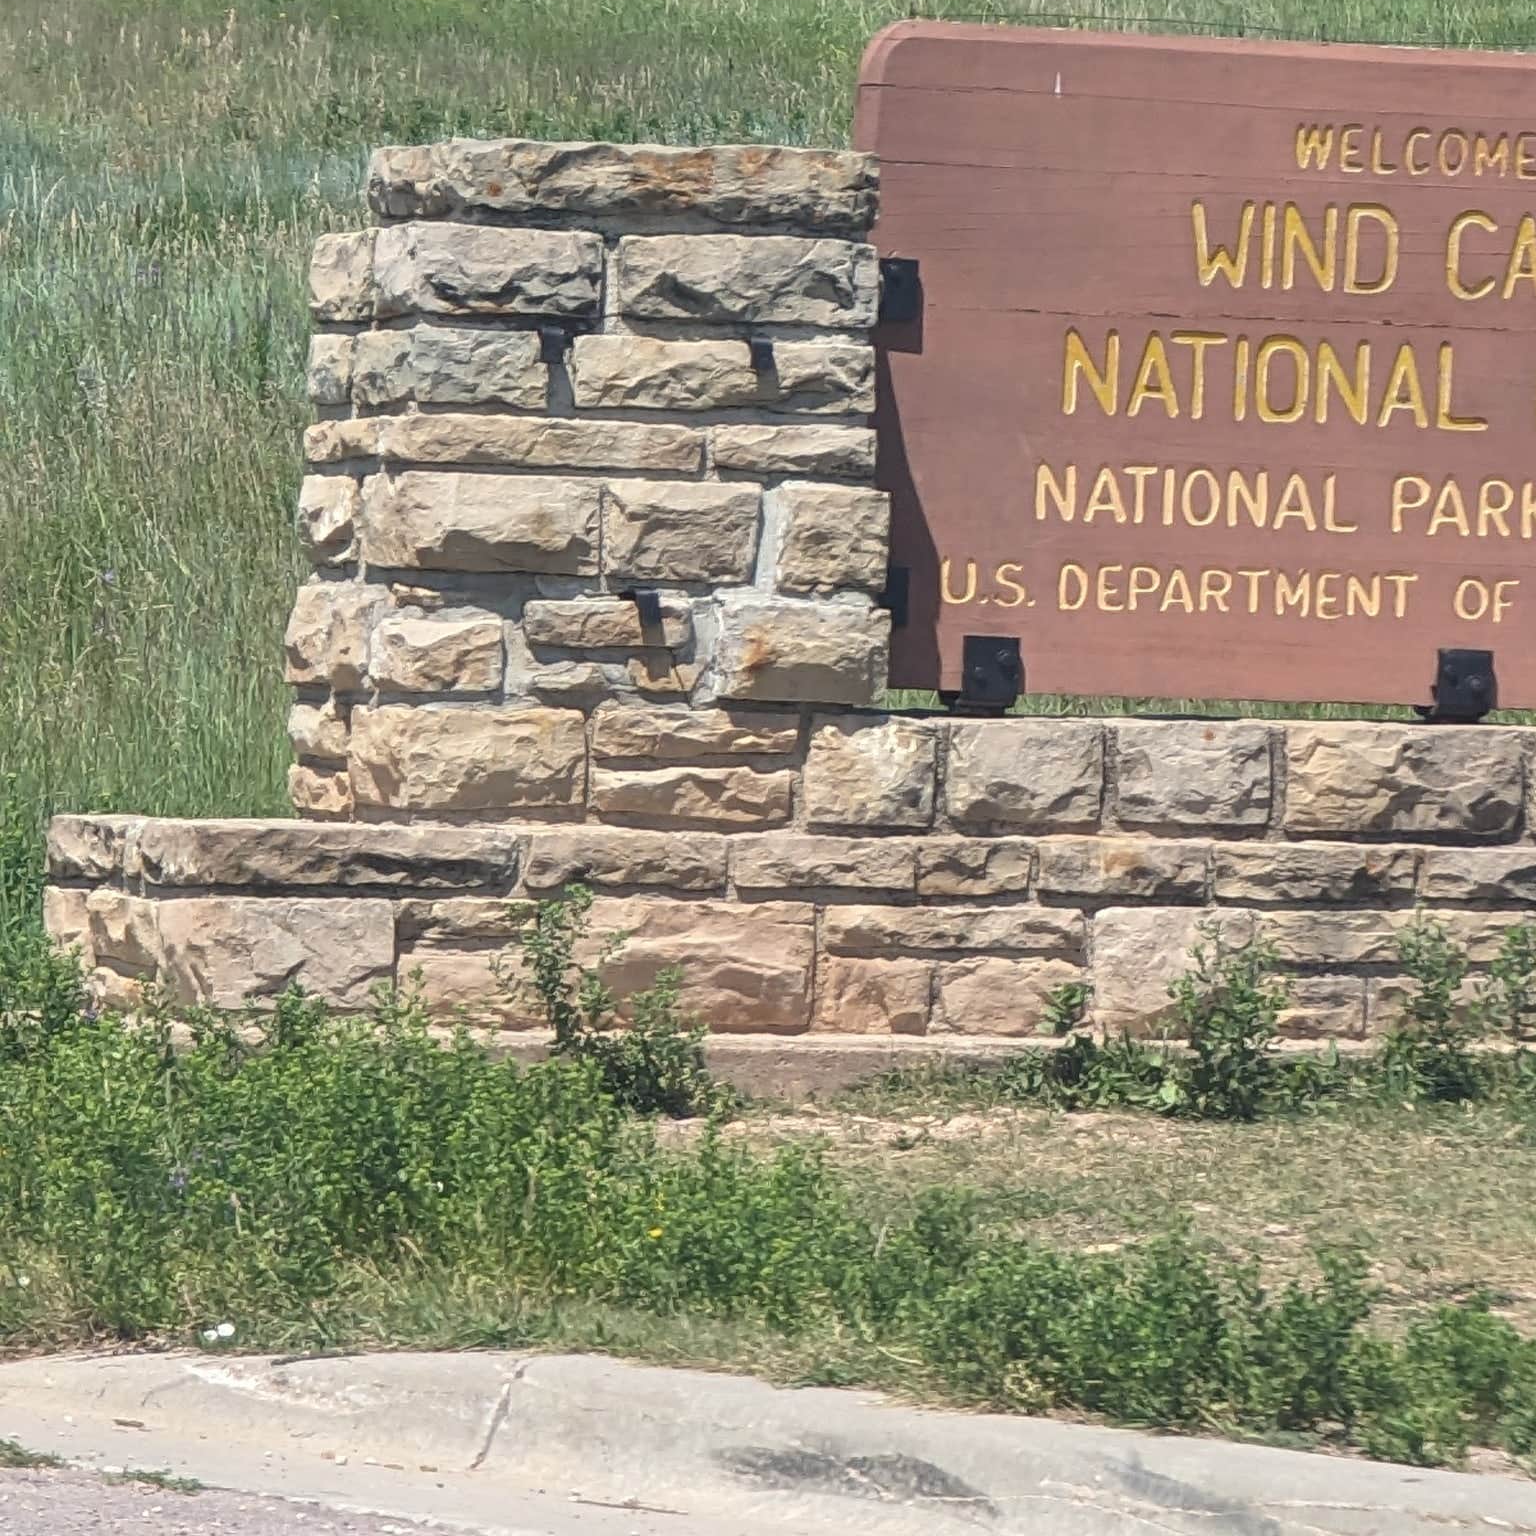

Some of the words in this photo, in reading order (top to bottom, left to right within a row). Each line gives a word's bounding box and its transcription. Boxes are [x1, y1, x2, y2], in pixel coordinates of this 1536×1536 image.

[1192, 200, 1400, 295] WIND
[1062, 327, 1488, 432] NATIONAL
[1034, 463, 1359, 535] NATIONAL
[938, 558, 1036, 609] U.S.
[1057, 562, 1420, 619] DEPARTMENT
[1452, 578, 1521, 623] OF
